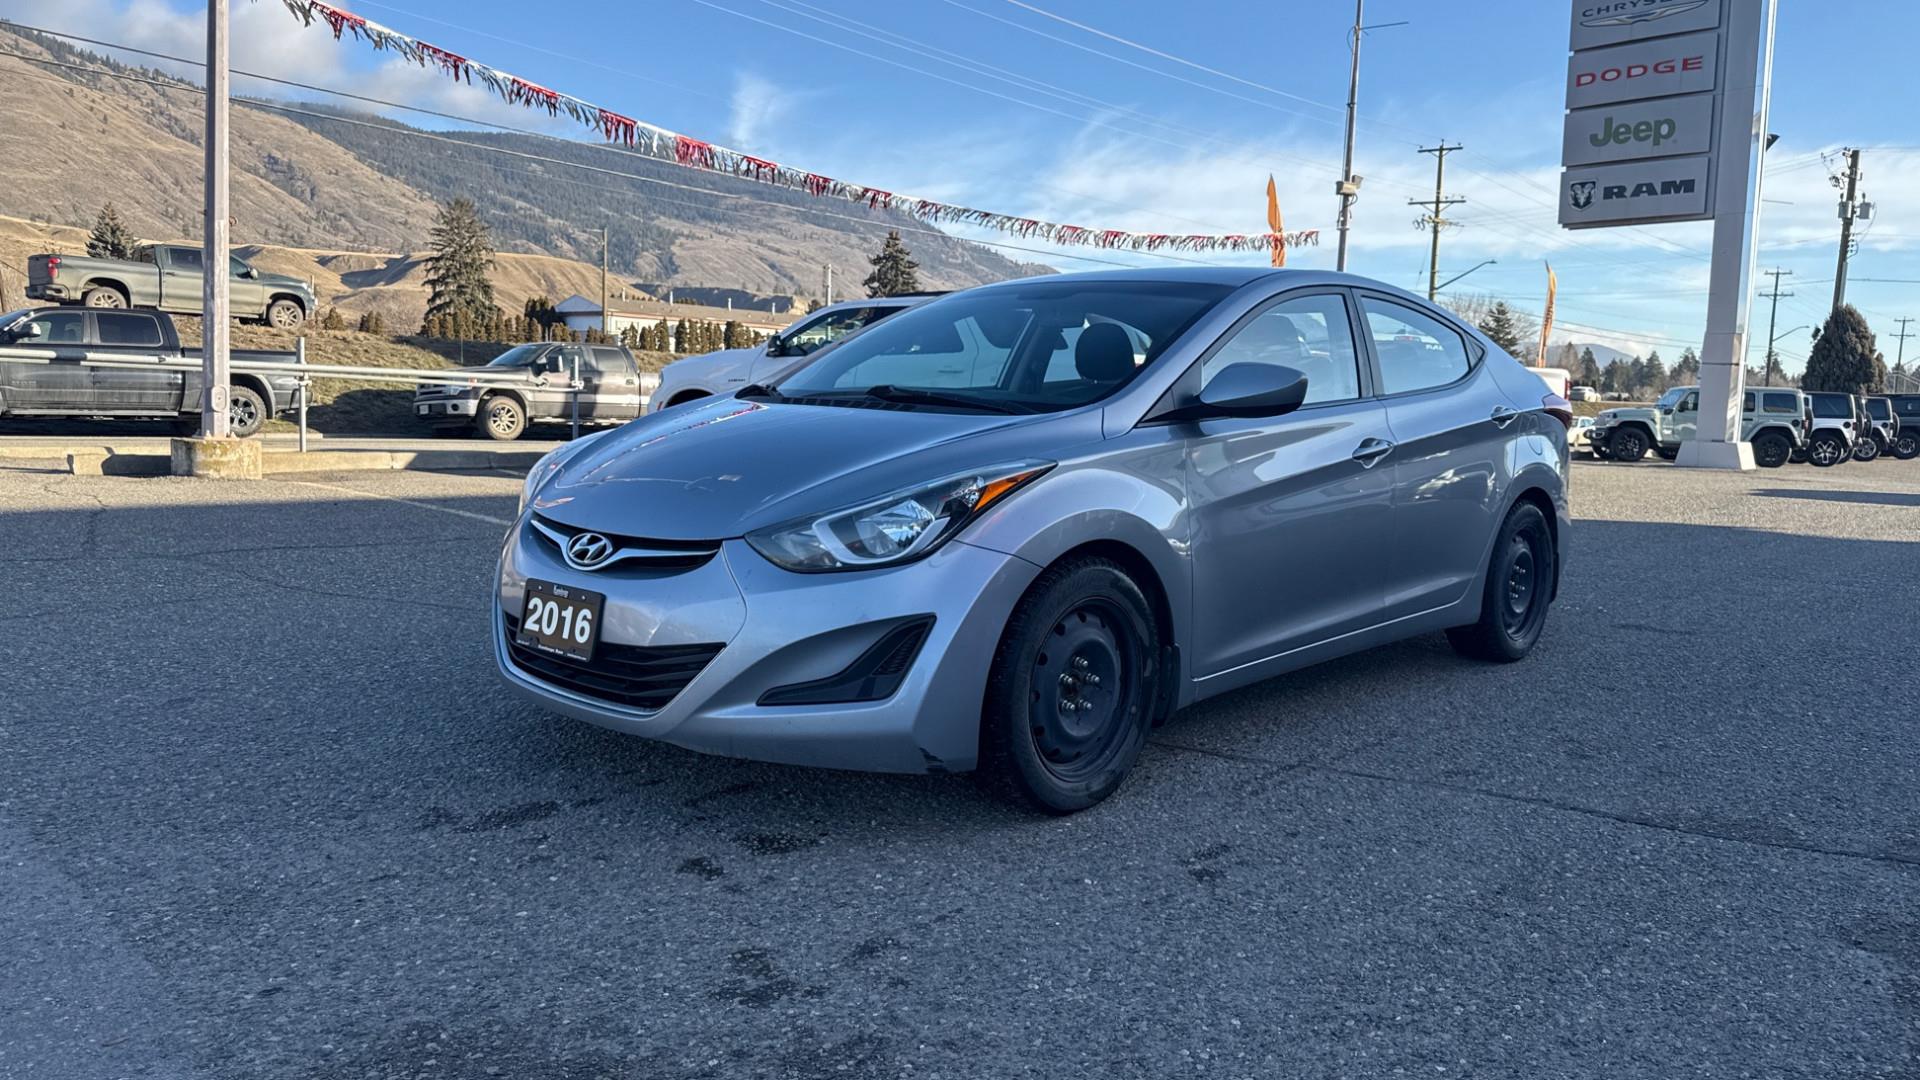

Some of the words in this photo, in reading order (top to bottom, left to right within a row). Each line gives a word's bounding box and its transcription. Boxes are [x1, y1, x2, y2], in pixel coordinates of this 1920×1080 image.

[1582, 0, 1673, 17] CHRYS
[1575, 56, 1704, 88] DODGE
[1589, 117, 1676, 147] Jeep
[1602, 179, 1696, 200] RAM
[524, 597, 592, 644] 2016
